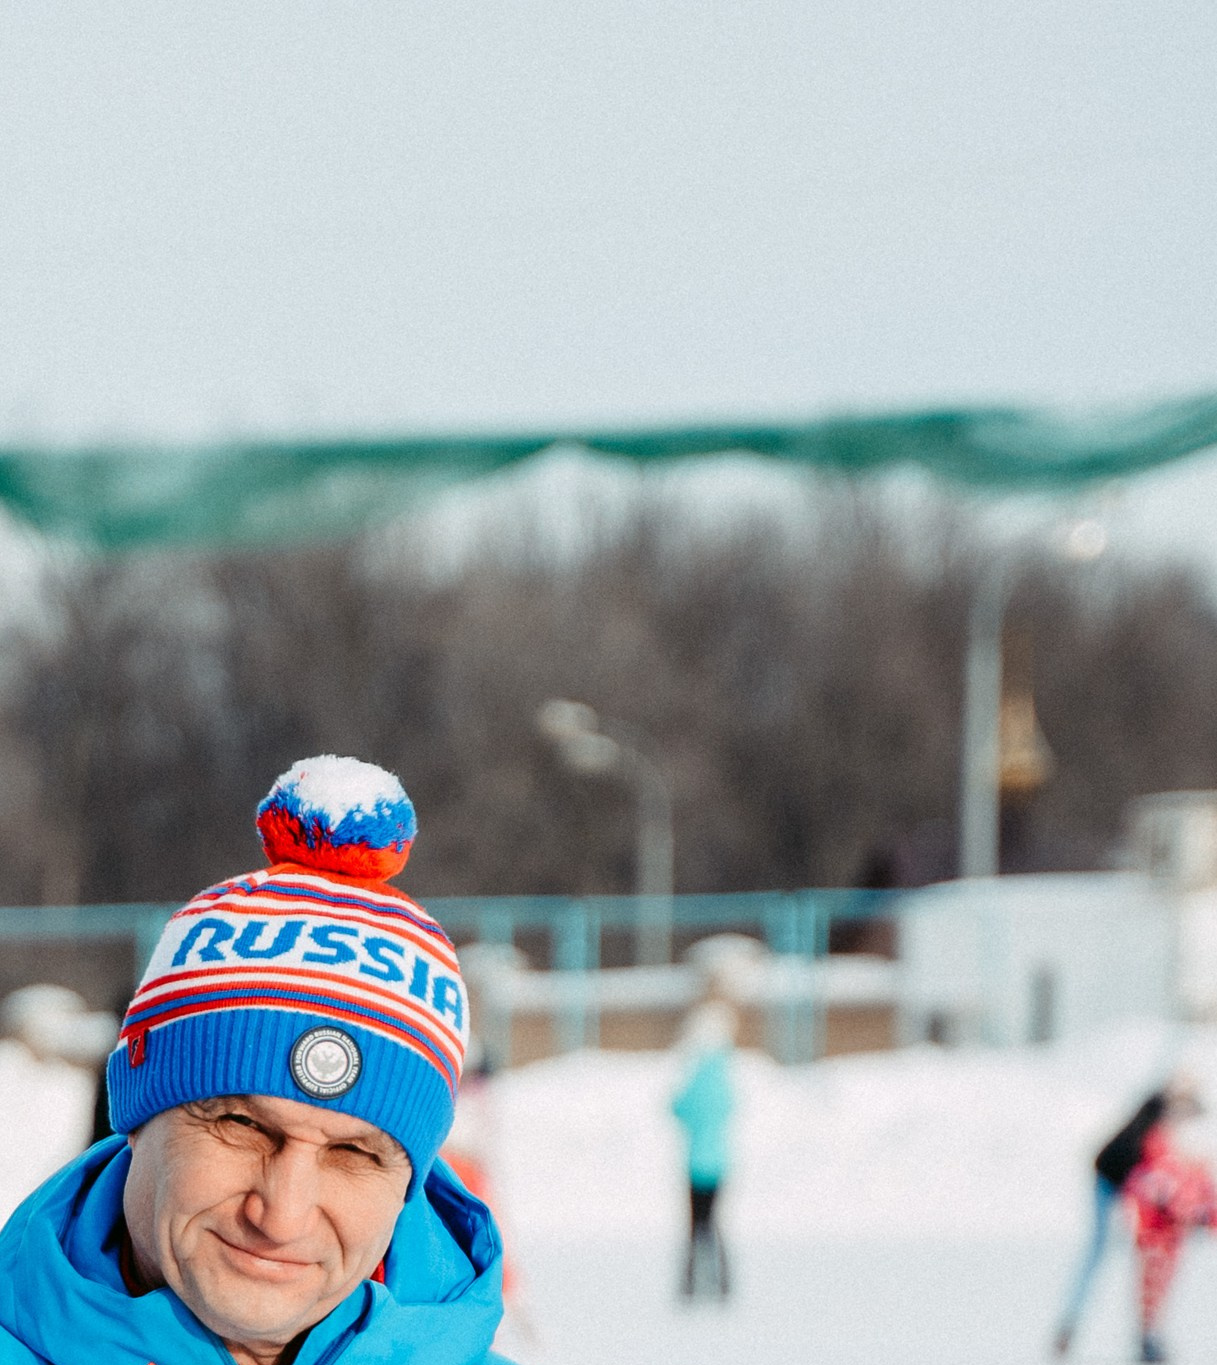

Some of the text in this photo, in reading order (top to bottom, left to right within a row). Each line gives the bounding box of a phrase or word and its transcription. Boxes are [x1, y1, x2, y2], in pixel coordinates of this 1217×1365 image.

[171, 918, 464, 1031] RUSSIA
[314, 1029, 342, 1038] RUSSIAN
[341, 1035, 359, 1065] NATIONAL
[295, 1065, 318, 1092] SUPPLIER
[346, 1066, 359, 1083] TEAM
